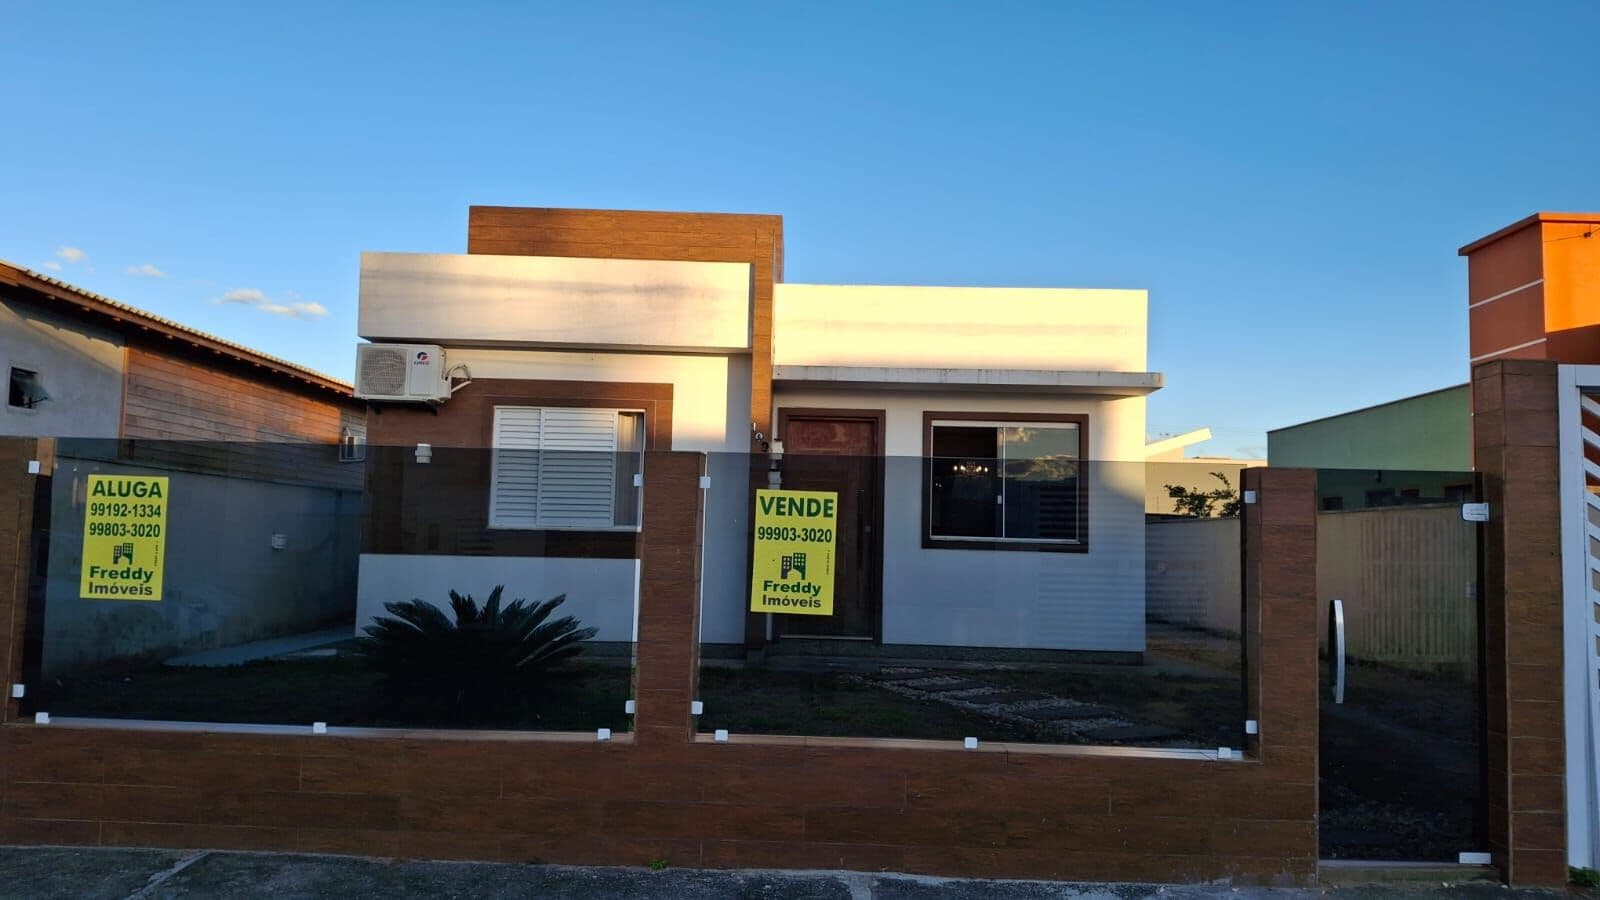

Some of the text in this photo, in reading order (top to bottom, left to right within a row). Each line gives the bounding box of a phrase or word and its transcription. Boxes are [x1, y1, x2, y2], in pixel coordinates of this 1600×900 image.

[92, 480, 162, 498] ALUGA
[90, 502, 161, 518] 99192-1334
[760, 495, 834, 518] VENDE
[89, 522, 160, 537] 99803-3020
[758, 526, 832, 543] 99903-3020
[89, 566, 153, 583] Freddy
[88, 581, 152, 595] Imóveis
[763, 580, 821, 597] Freddy
[762, 594, 821, 608] Imóveis
